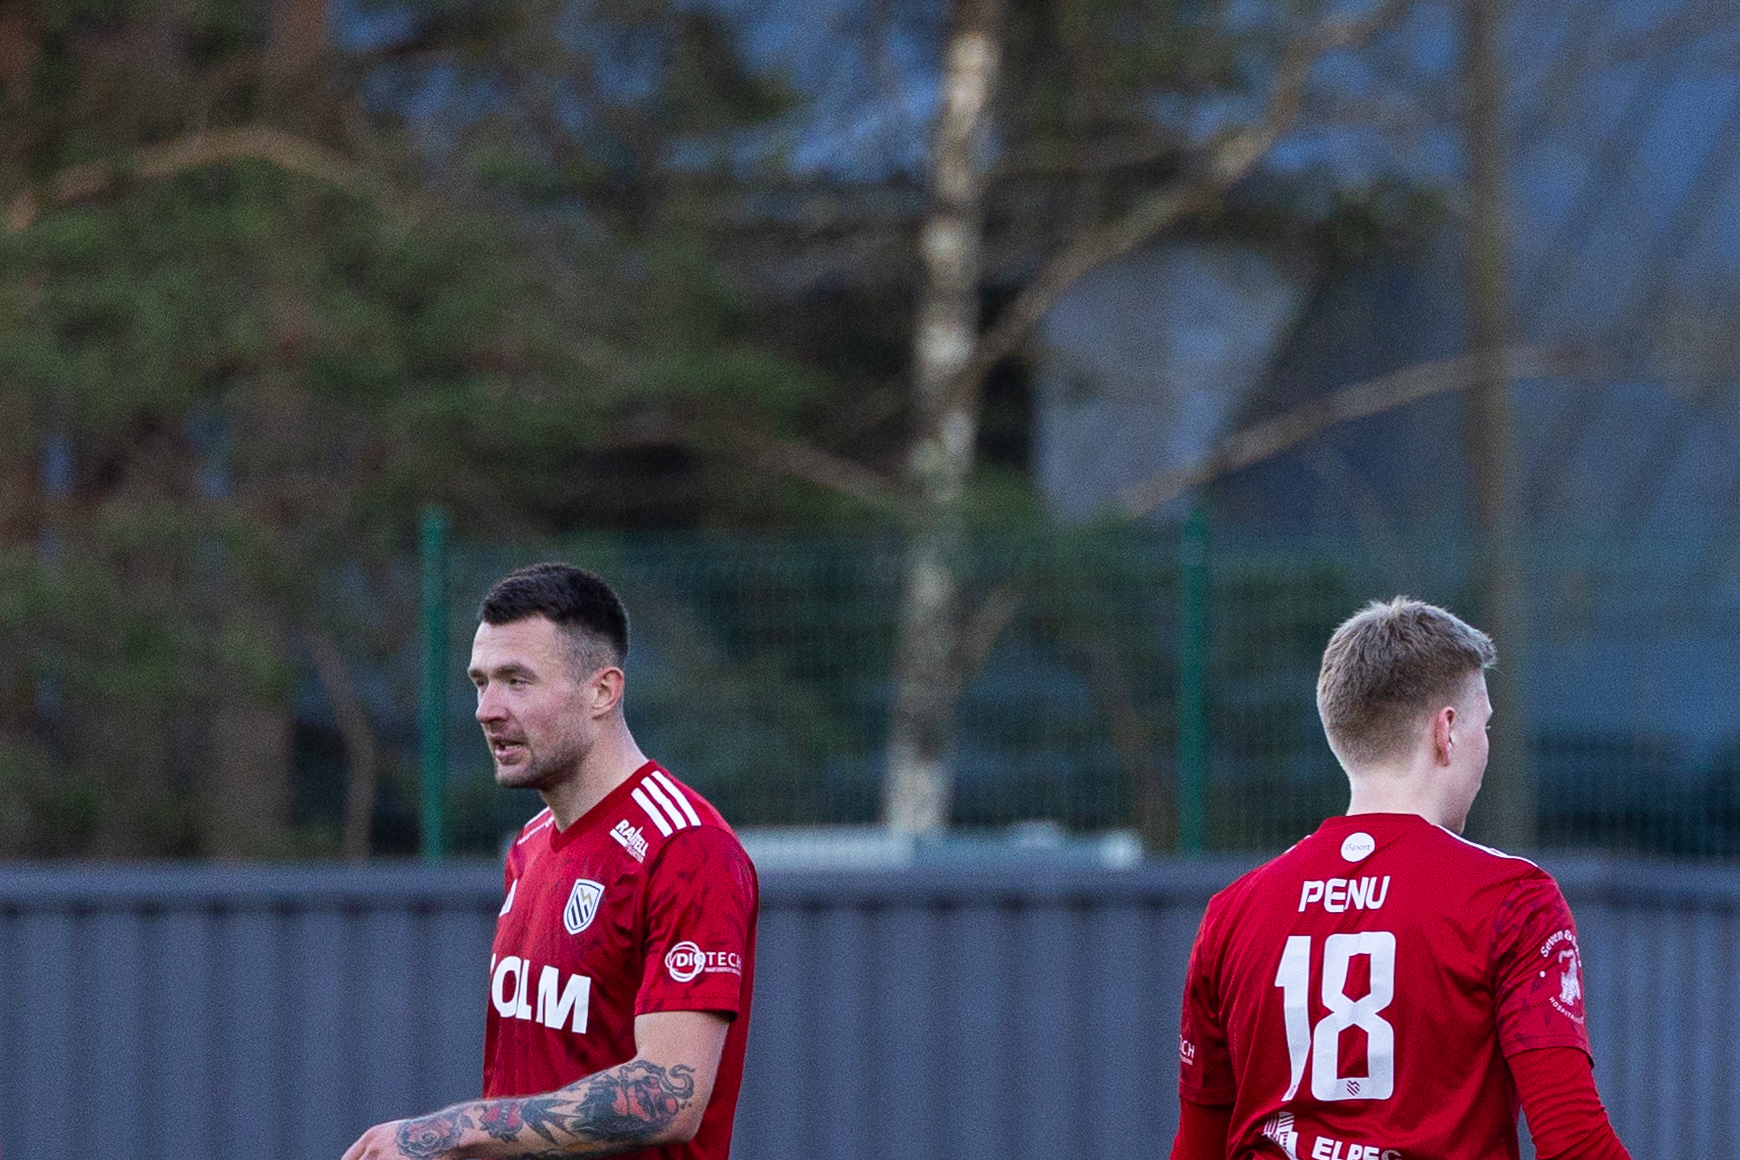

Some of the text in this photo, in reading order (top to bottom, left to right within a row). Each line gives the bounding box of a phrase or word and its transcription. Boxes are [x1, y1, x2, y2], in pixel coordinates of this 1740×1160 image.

[1298, 876, 1390, 913] PENU
[490, 953, 592, 1034] OLM
[1275, 931, 1397, 1102] 18
